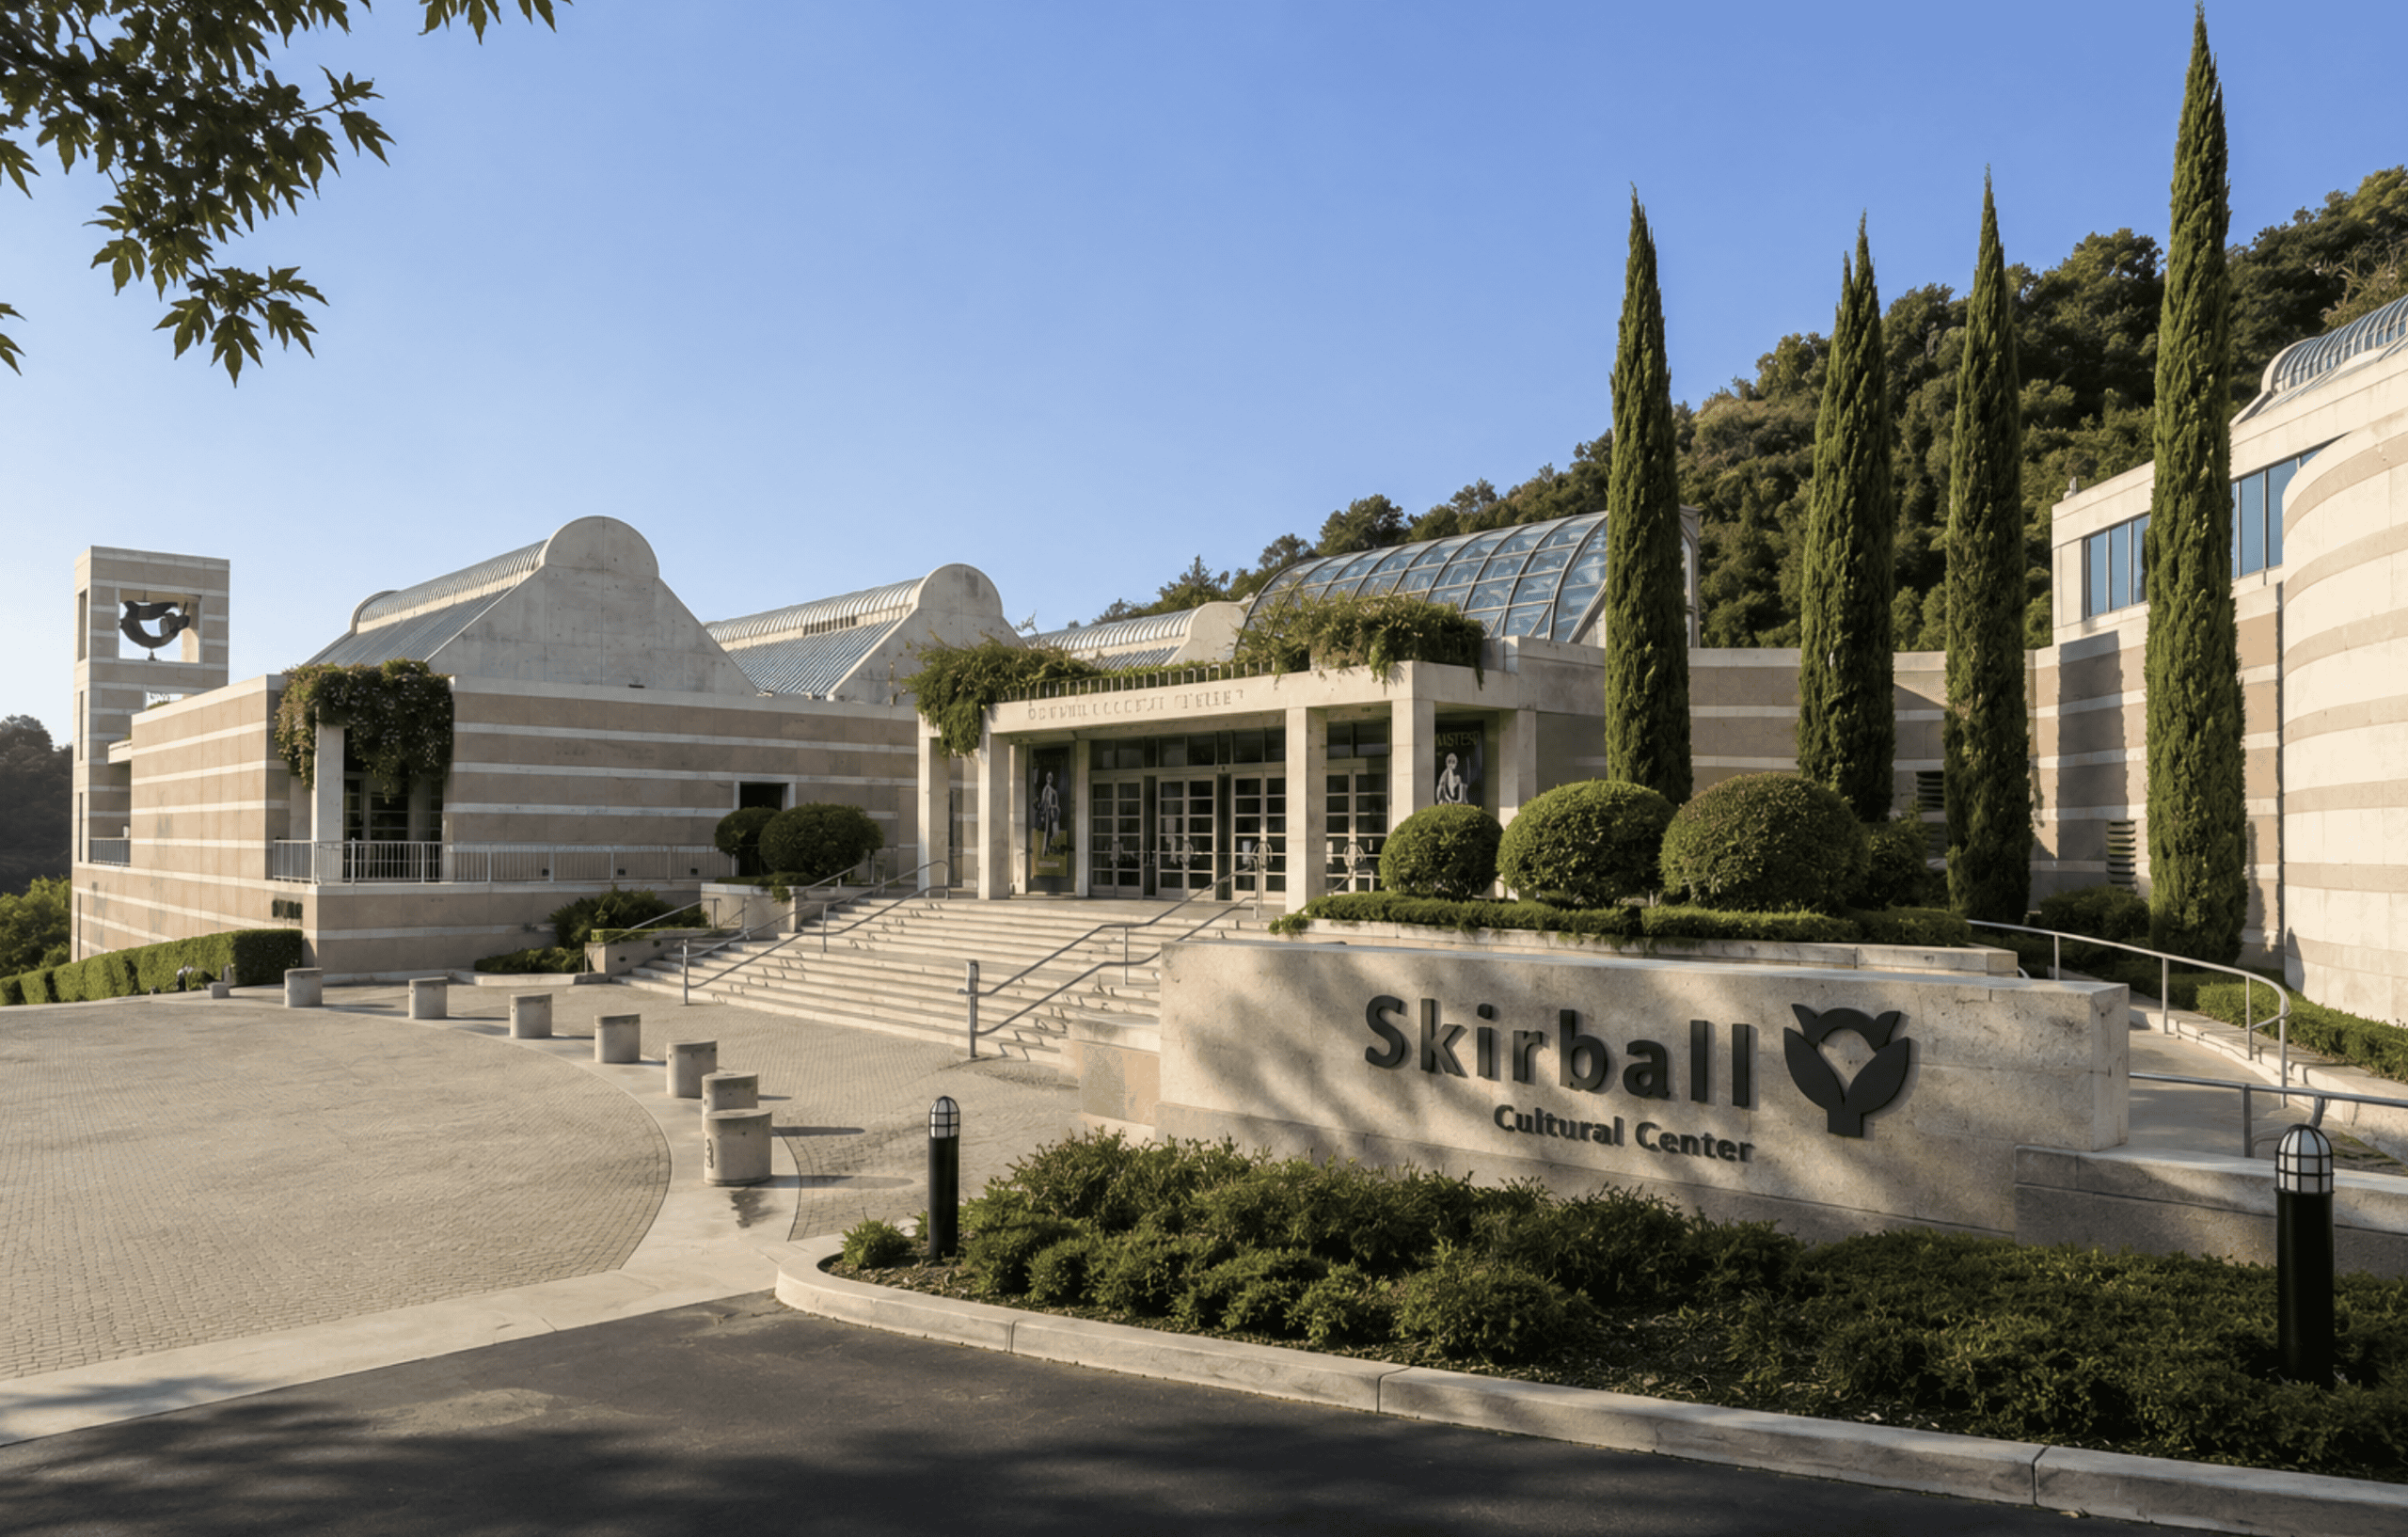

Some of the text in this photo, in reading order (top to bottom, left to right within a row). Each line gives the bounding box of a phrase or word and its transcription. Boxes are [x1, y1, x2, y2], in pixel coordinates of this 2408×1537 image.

[1366, 994, 1753, 1108] Skirball
[1494, 1104, 1755, 1163] Cultural Center
